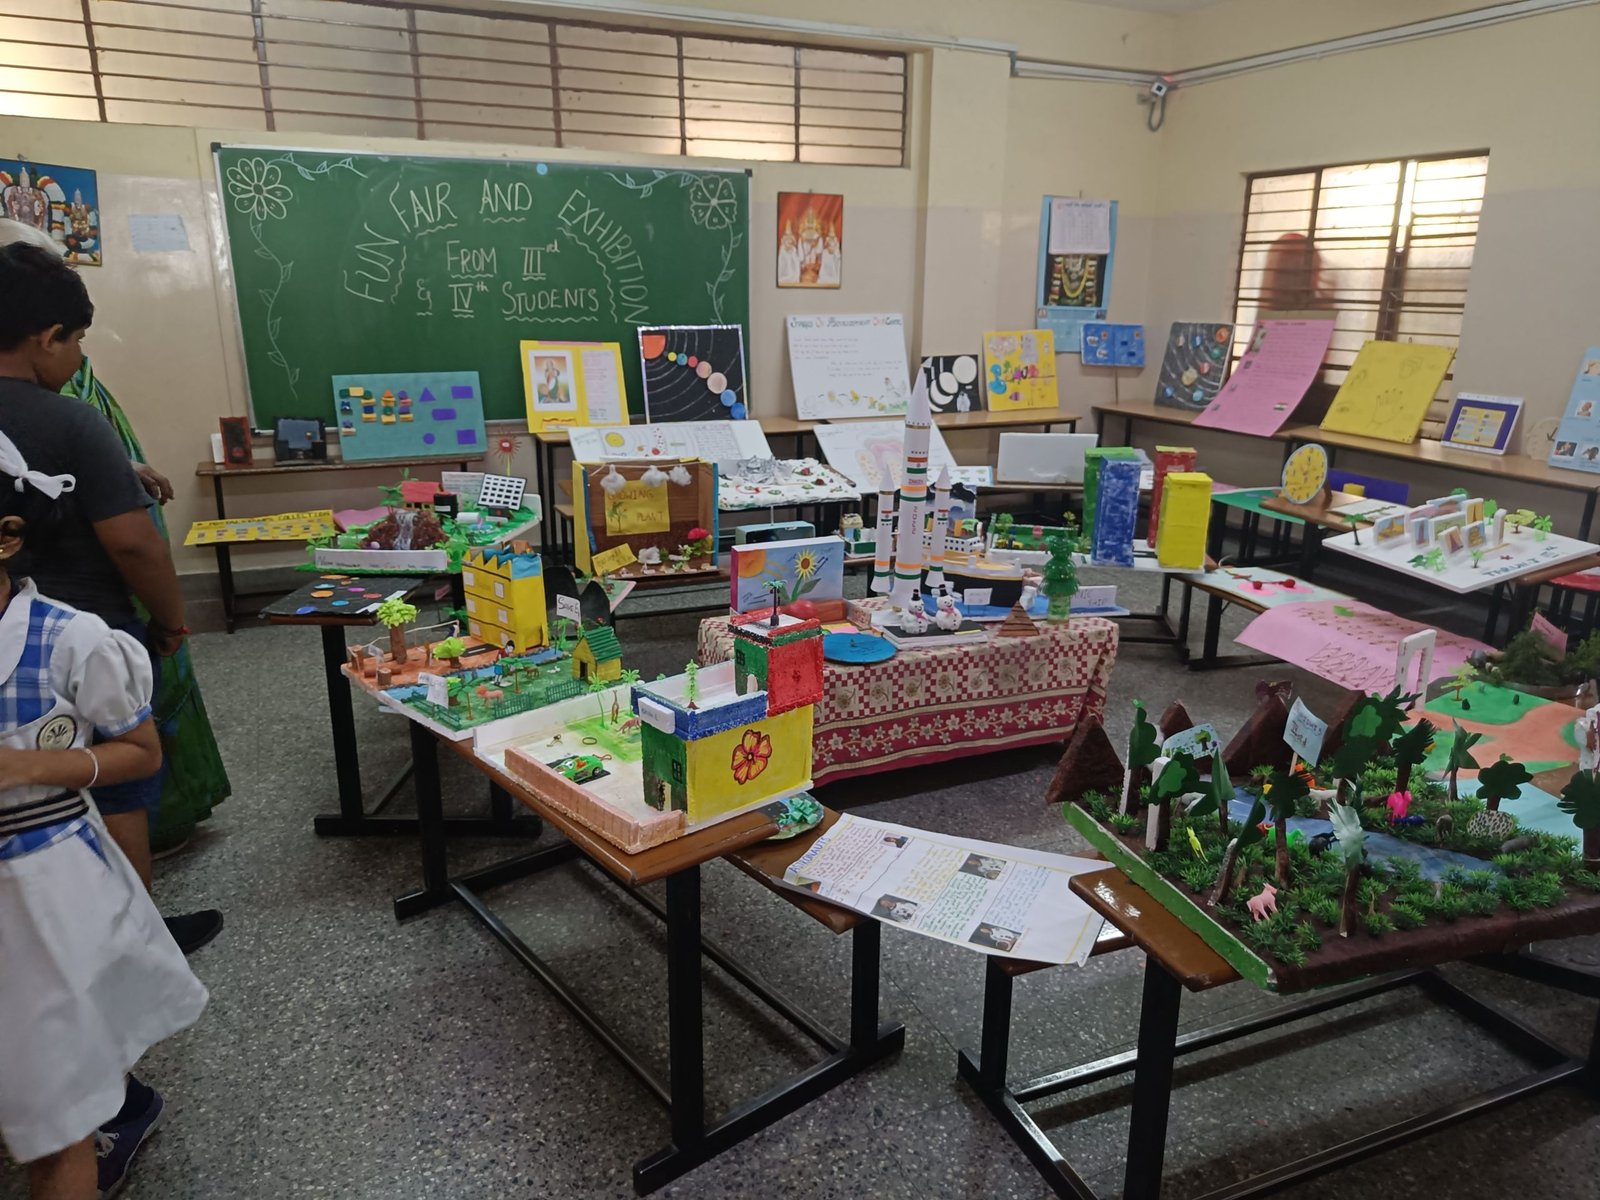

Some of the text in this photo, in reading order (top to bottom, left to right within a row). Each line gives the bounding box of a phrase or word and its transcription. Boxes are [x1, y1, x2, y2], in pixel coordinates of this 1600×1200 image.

[344, 179, 650, 325] FUN FAIR AND EXHIBITION
[447, 240, 497, 274] FROM
